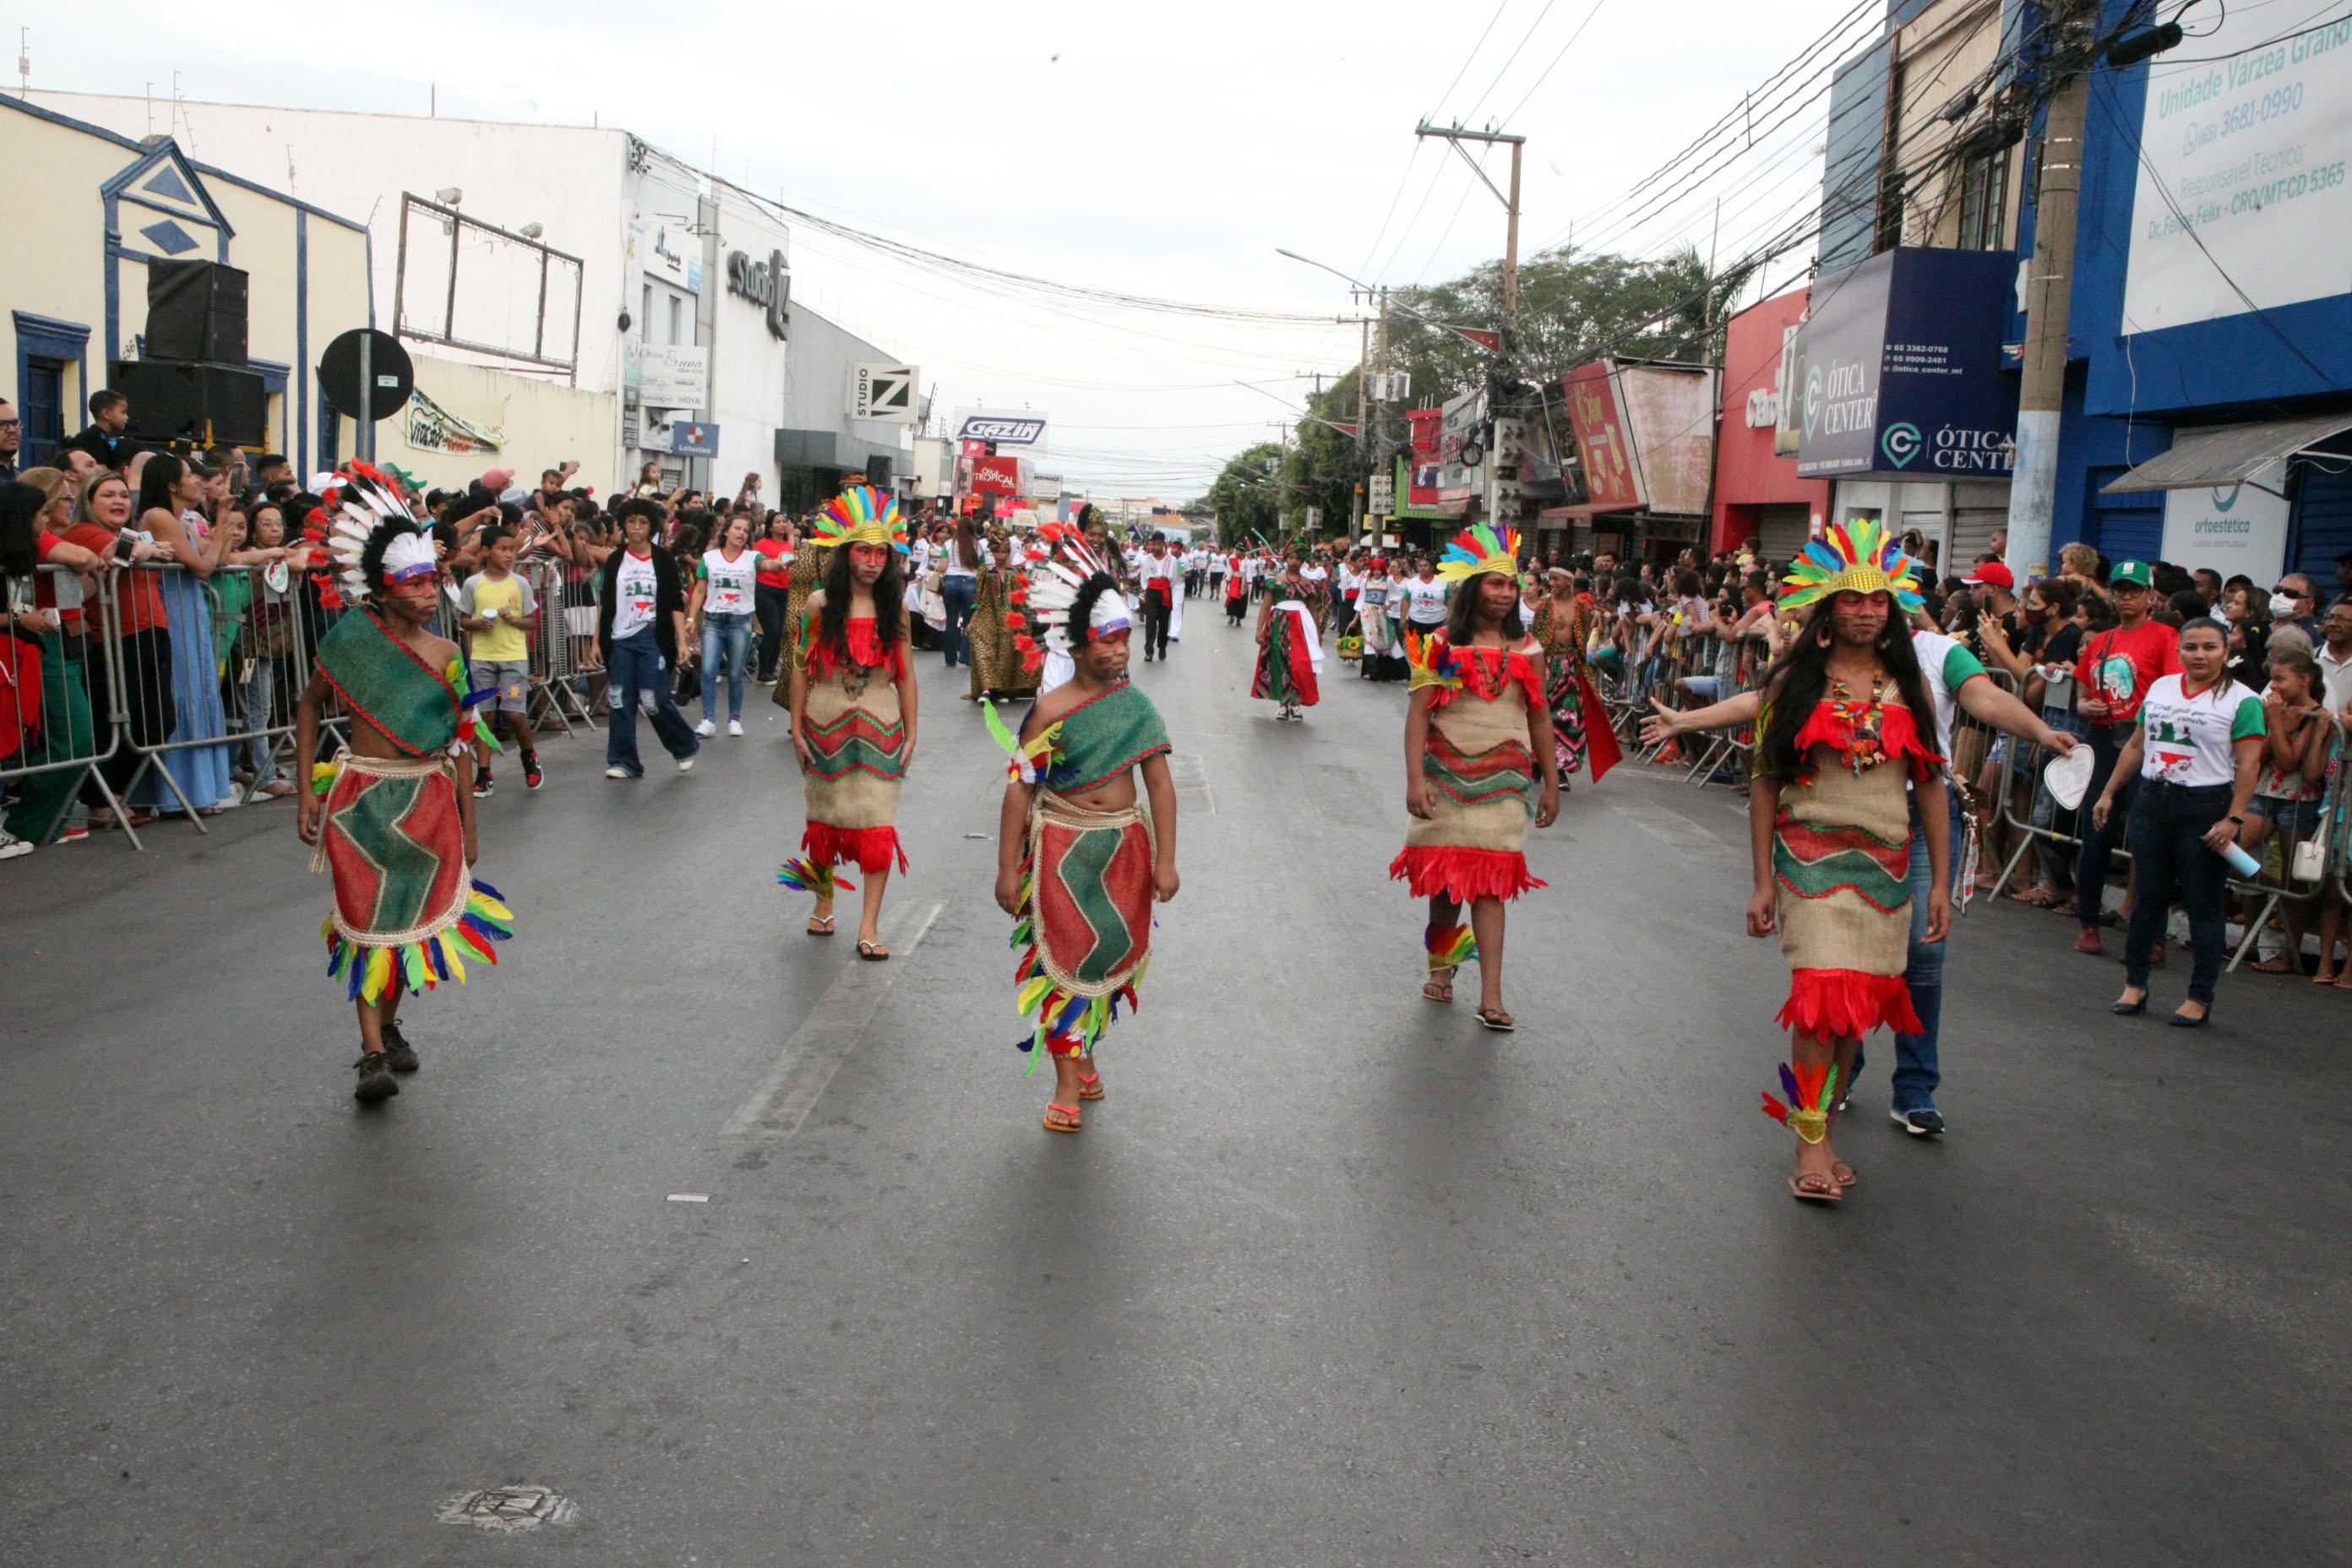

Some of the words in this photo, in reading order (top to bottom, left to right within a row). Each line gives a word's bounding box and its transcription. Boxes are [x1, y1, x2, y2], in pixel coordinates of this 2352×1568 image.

[2159, 69, 2222, 119] Unidade
[2228, 46, 2285, 91] Várzea
[2291, 8, 2352, 65] Grand
[2198, 123, 2218, 145] (65)
[2220, 82, 2303, 136] 3681-0990
[2148, 220, 2161, 240] Dr.
[2231, 174, 2306, 215] CRO/MT-CD
[2309, 161, 2346, 193] 5365
[727, 251, 776, 307] Studio
[1827, 359, 1865, 400] ÓTICA
[1892, 365, 1963, 375] @otica_center_mt
[678, 395, 700, 406] HOYA
[858, 368, 868, 416] STUDIO
[966, 421, 1042, 441] GAZIN
[1824, 397, 1874, 435] CENTER
[678, 444, 711, 454] Loterias
[1936, 423, 2015, 450] ÓTICA
[975, 473, 1015, 487] TROPICAL
[2194, 517, 2251, 533] ortoestética
